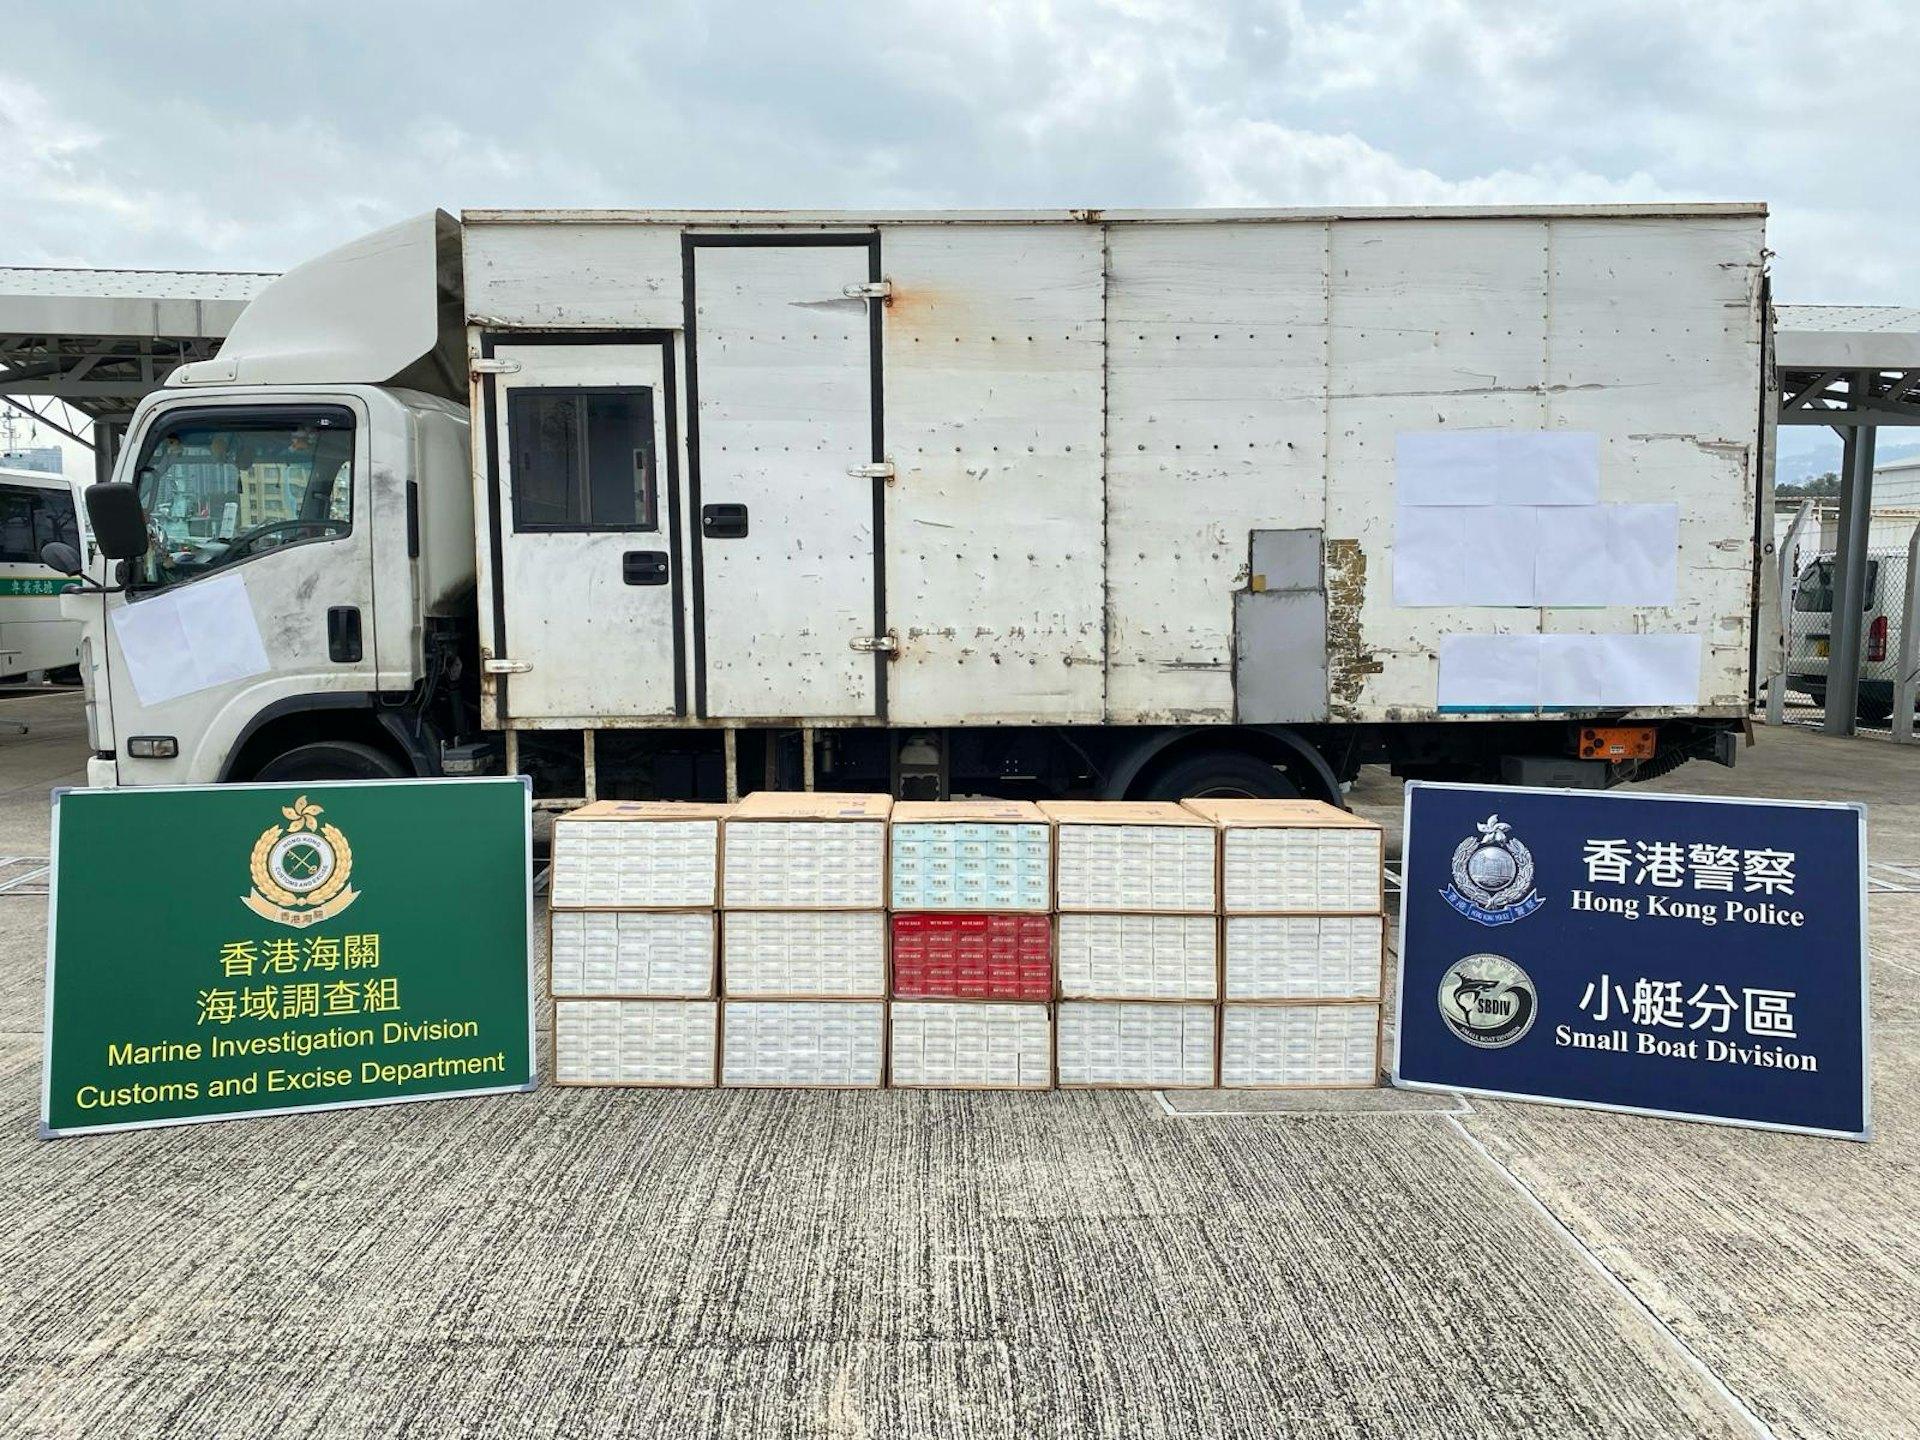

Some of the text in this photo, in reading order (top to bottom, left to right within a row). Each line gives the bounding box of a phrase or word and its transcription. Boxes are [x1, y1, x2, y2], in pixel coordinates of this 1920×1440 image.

[282, 837, 321, 849] HONG KONG
[1583, 839, 1796, 896] 香港警察
[275, 866, 298, 888] CUSTOMS
[299, 880, 313, 888] AND
[1570, 889, 1806, 927] Hong Kong Police
[219, 933, 380, 978] 香港海關
[196, 977, 401, 1026] 海域調查組
[1477, 998, 1511, 1016] SBDIV
[1578, 973, 1798, 1039] 小艇分區
[108, 1018, 479, 1067] Marine Investigation Division
[1555, 1024, 1819, 1073] Small Boat Division
[76, 1051, 506, 1109] Customs and Excise Department
